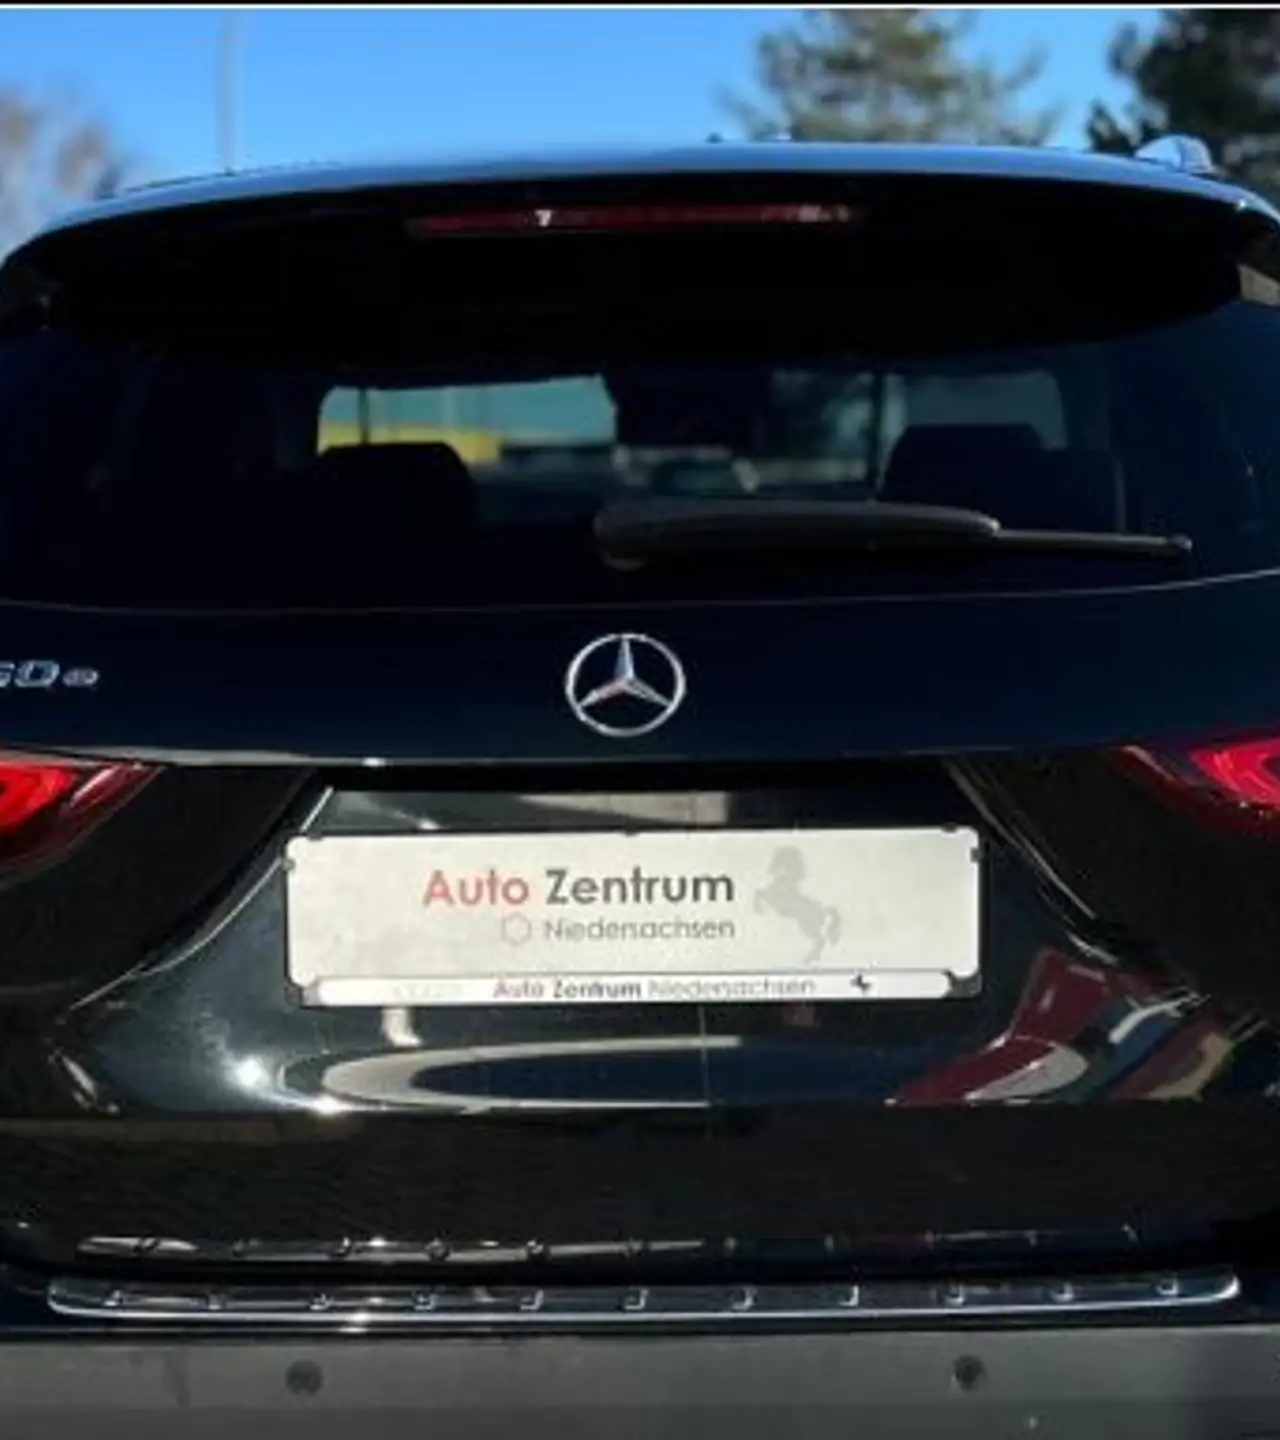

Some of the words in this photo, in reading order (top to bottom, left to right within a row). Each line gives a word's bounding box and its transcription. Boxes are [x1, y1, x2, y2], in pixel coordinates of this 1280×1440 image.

[422, 868, 531, 907] Auto
[544, 864, 736, 905] Zentrum
[544, 916, 736, 942] Niedersachsen
[492, 978, 545, 999] Auto
[552, 978, 642, 998] Zentrum
[647, 976, 816, 998] Niedersachsen
